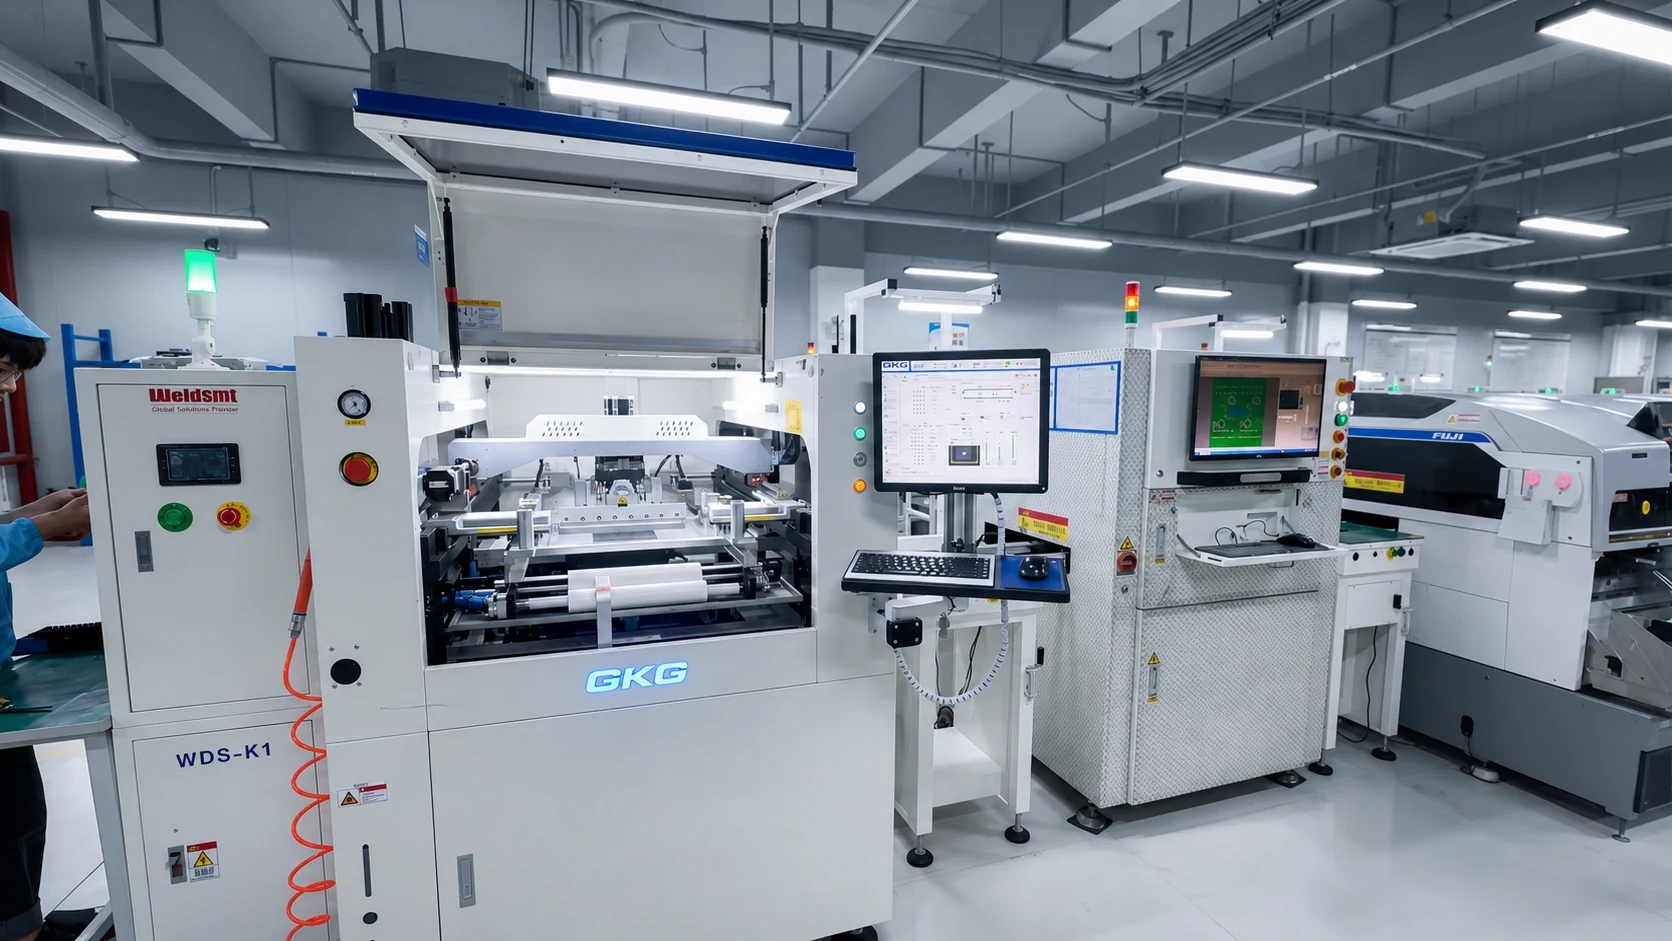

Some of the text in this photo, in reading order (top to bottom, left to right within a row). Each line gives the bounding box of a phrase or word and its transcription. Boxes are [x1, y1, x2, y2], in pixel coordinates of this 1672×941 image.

[149, 388, 238, 403] Weldsmt
[1432, 432, 1464, 440] FUJI
[585, 661, 689, 693] GKG
[176, 742, 271, 768] WDS-K1
